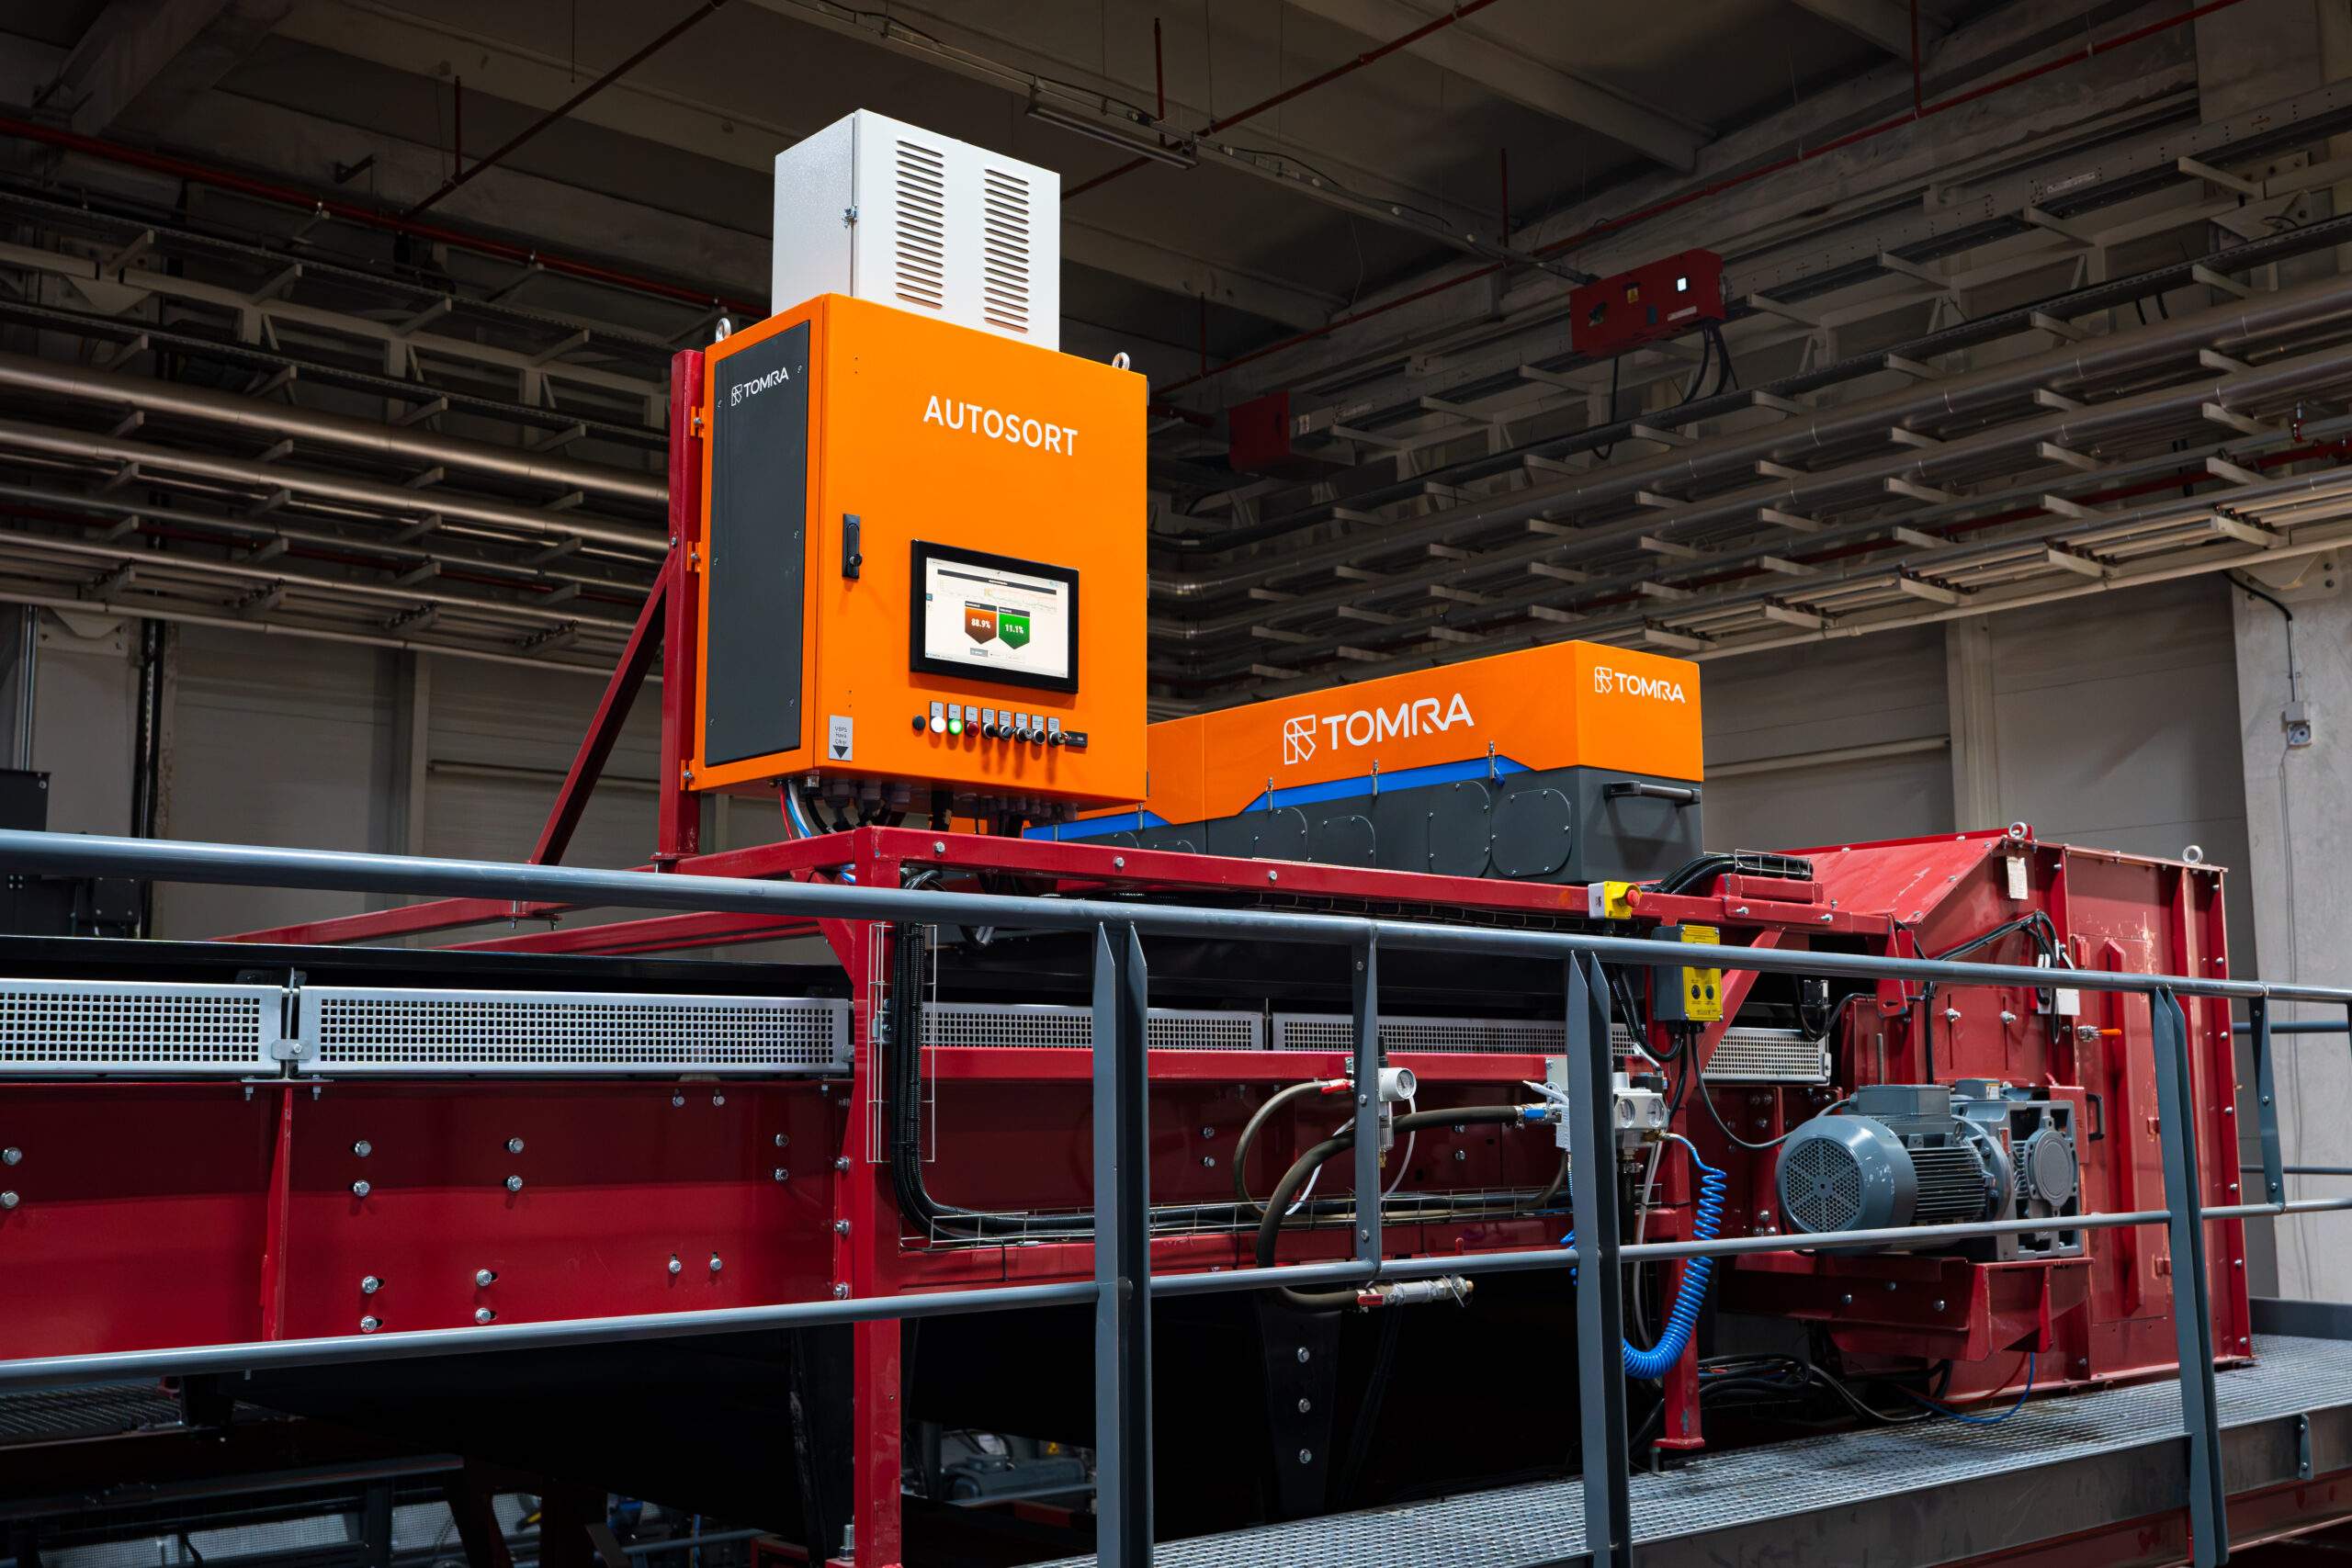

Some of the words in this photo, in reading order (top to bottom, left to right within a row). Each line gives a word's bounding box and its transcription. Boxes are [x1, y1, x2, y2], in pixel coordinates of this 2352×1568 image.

[743, 367, 789, 398] TOMRA
[923, 396, 1078, 456] AUTOSORT
[1615, 672, 1686, 704] TOMRA
[1321, 694, 1475, 750] TOMRA
